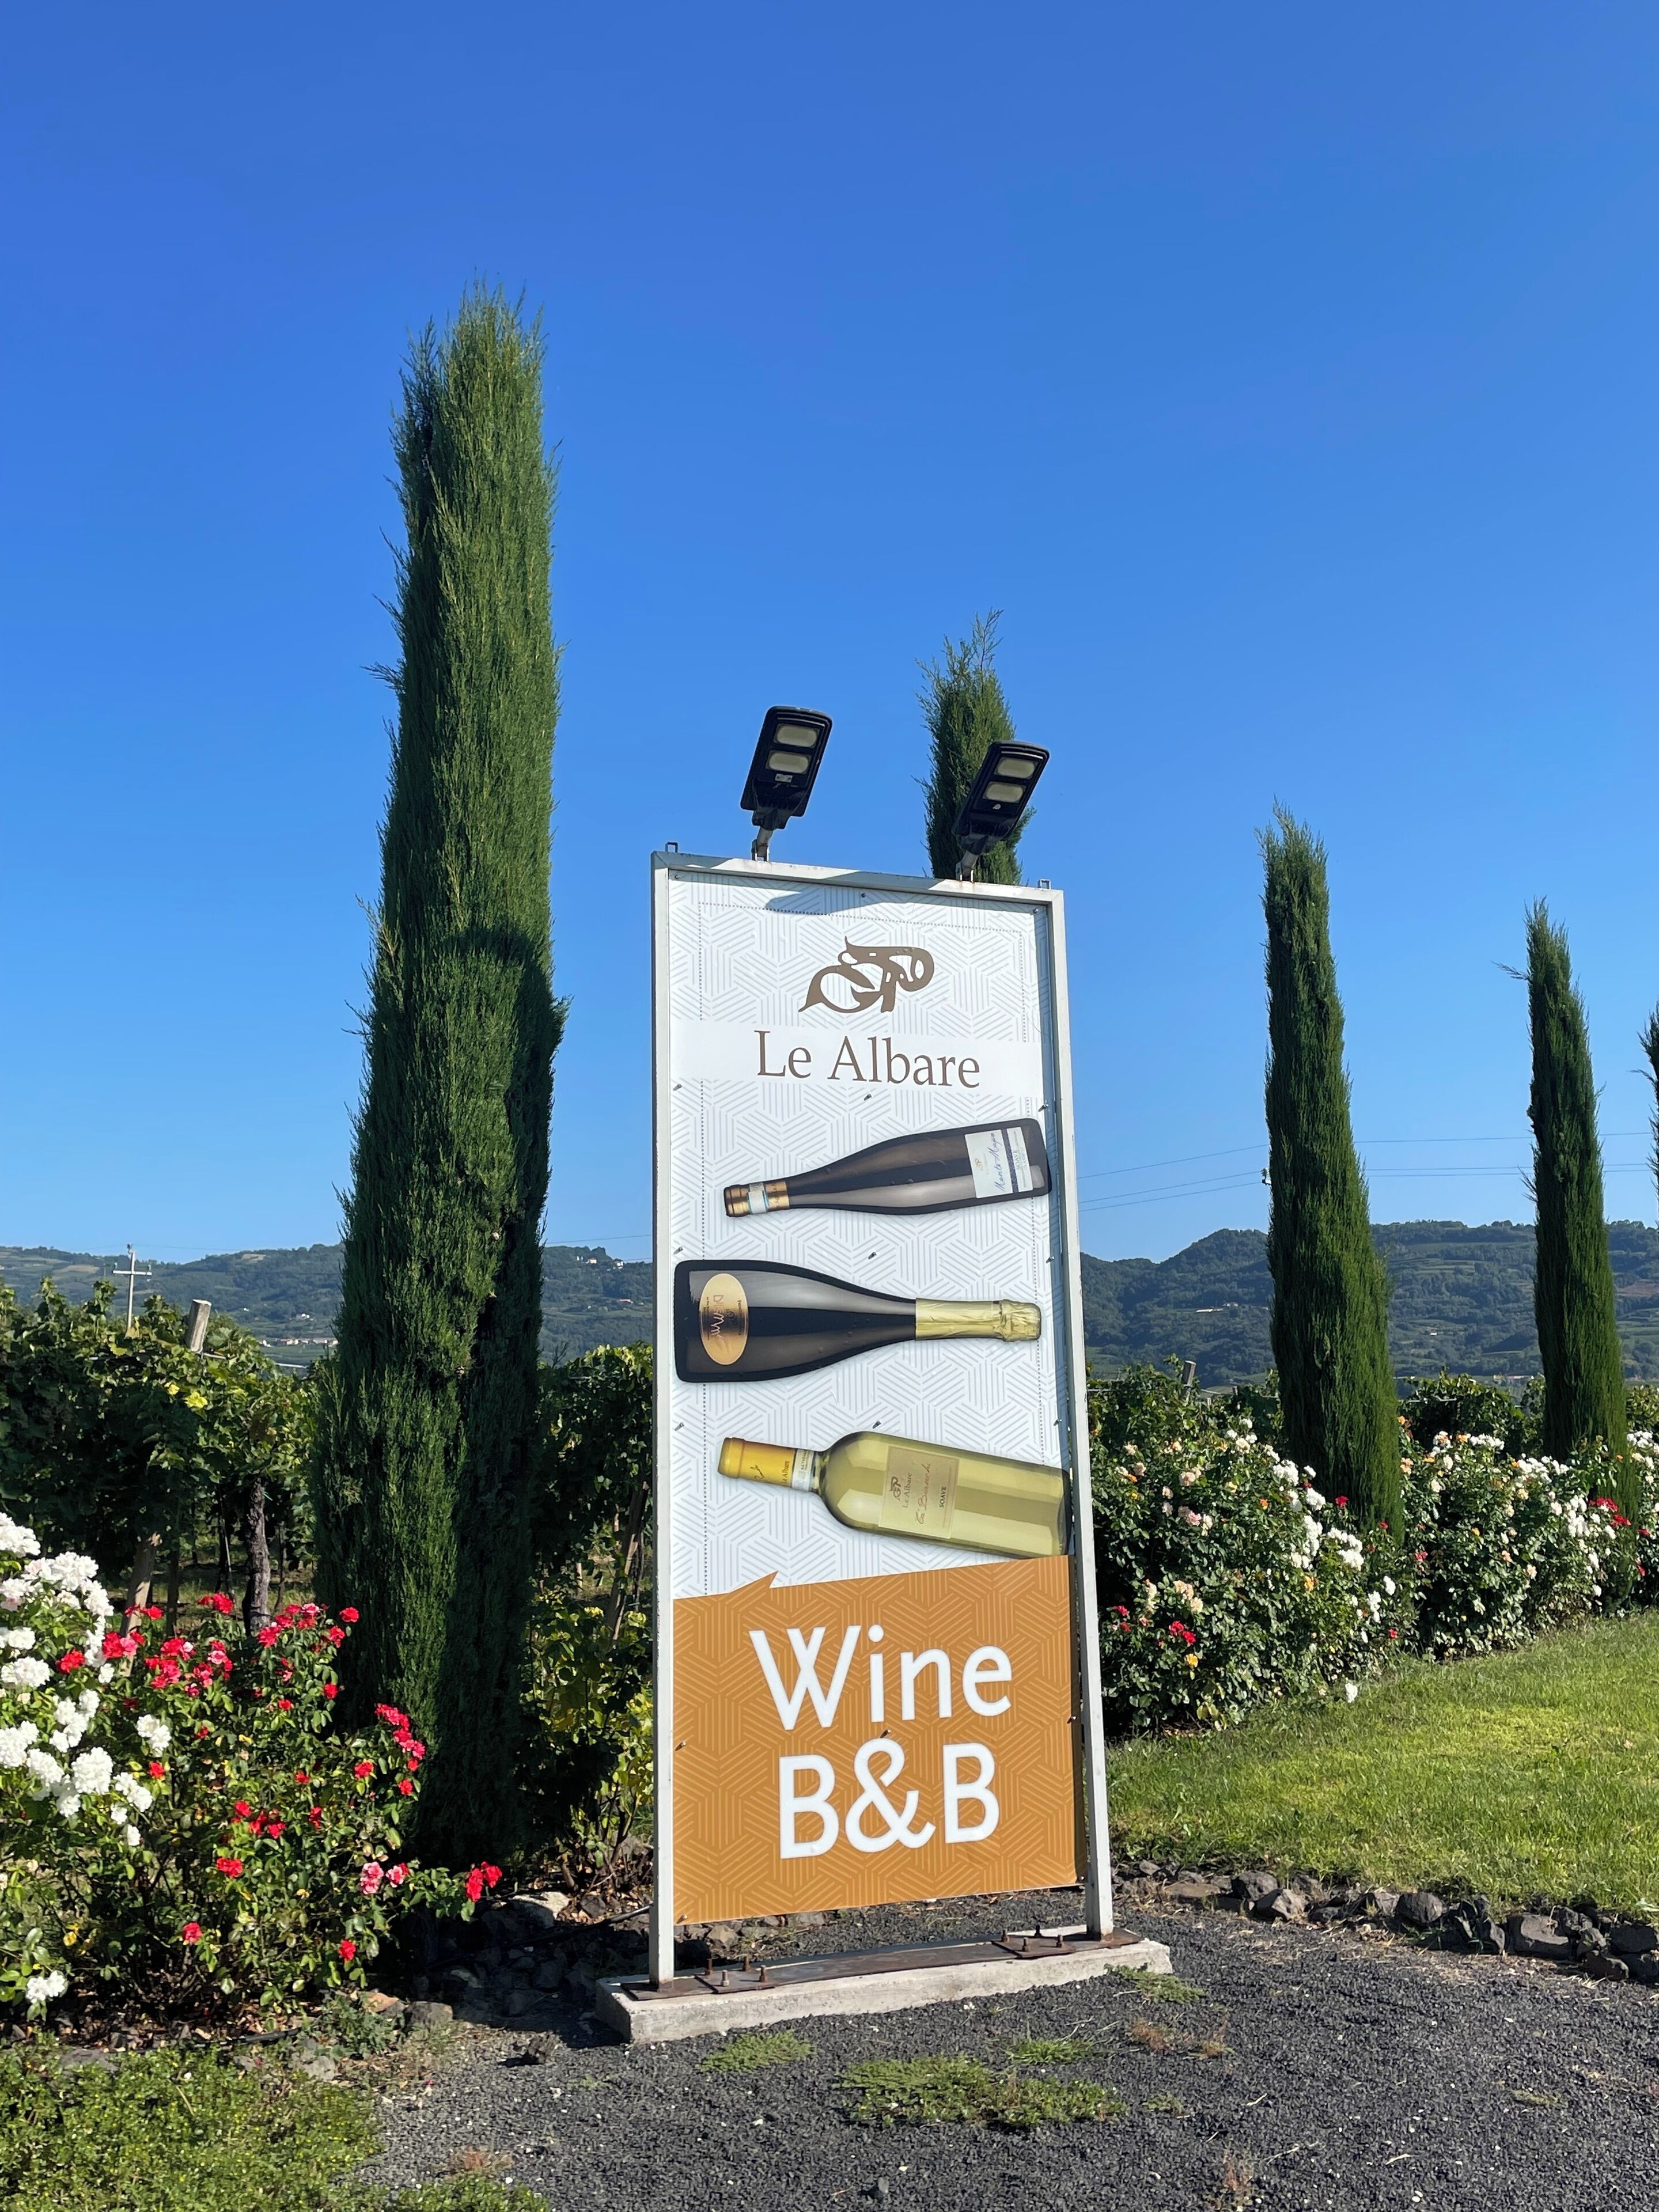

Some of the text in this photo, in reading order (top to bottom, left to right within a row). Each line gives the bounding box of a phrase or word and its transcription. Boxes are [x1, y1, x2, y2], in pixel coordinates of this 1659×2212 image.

[753, 1030, 980, 1088] Le Albare
[903, 1472, 912, 1498] Albare
[749, 1624, 1013, 1730] Wine
[779, 1738, 999, 1860] B&B
